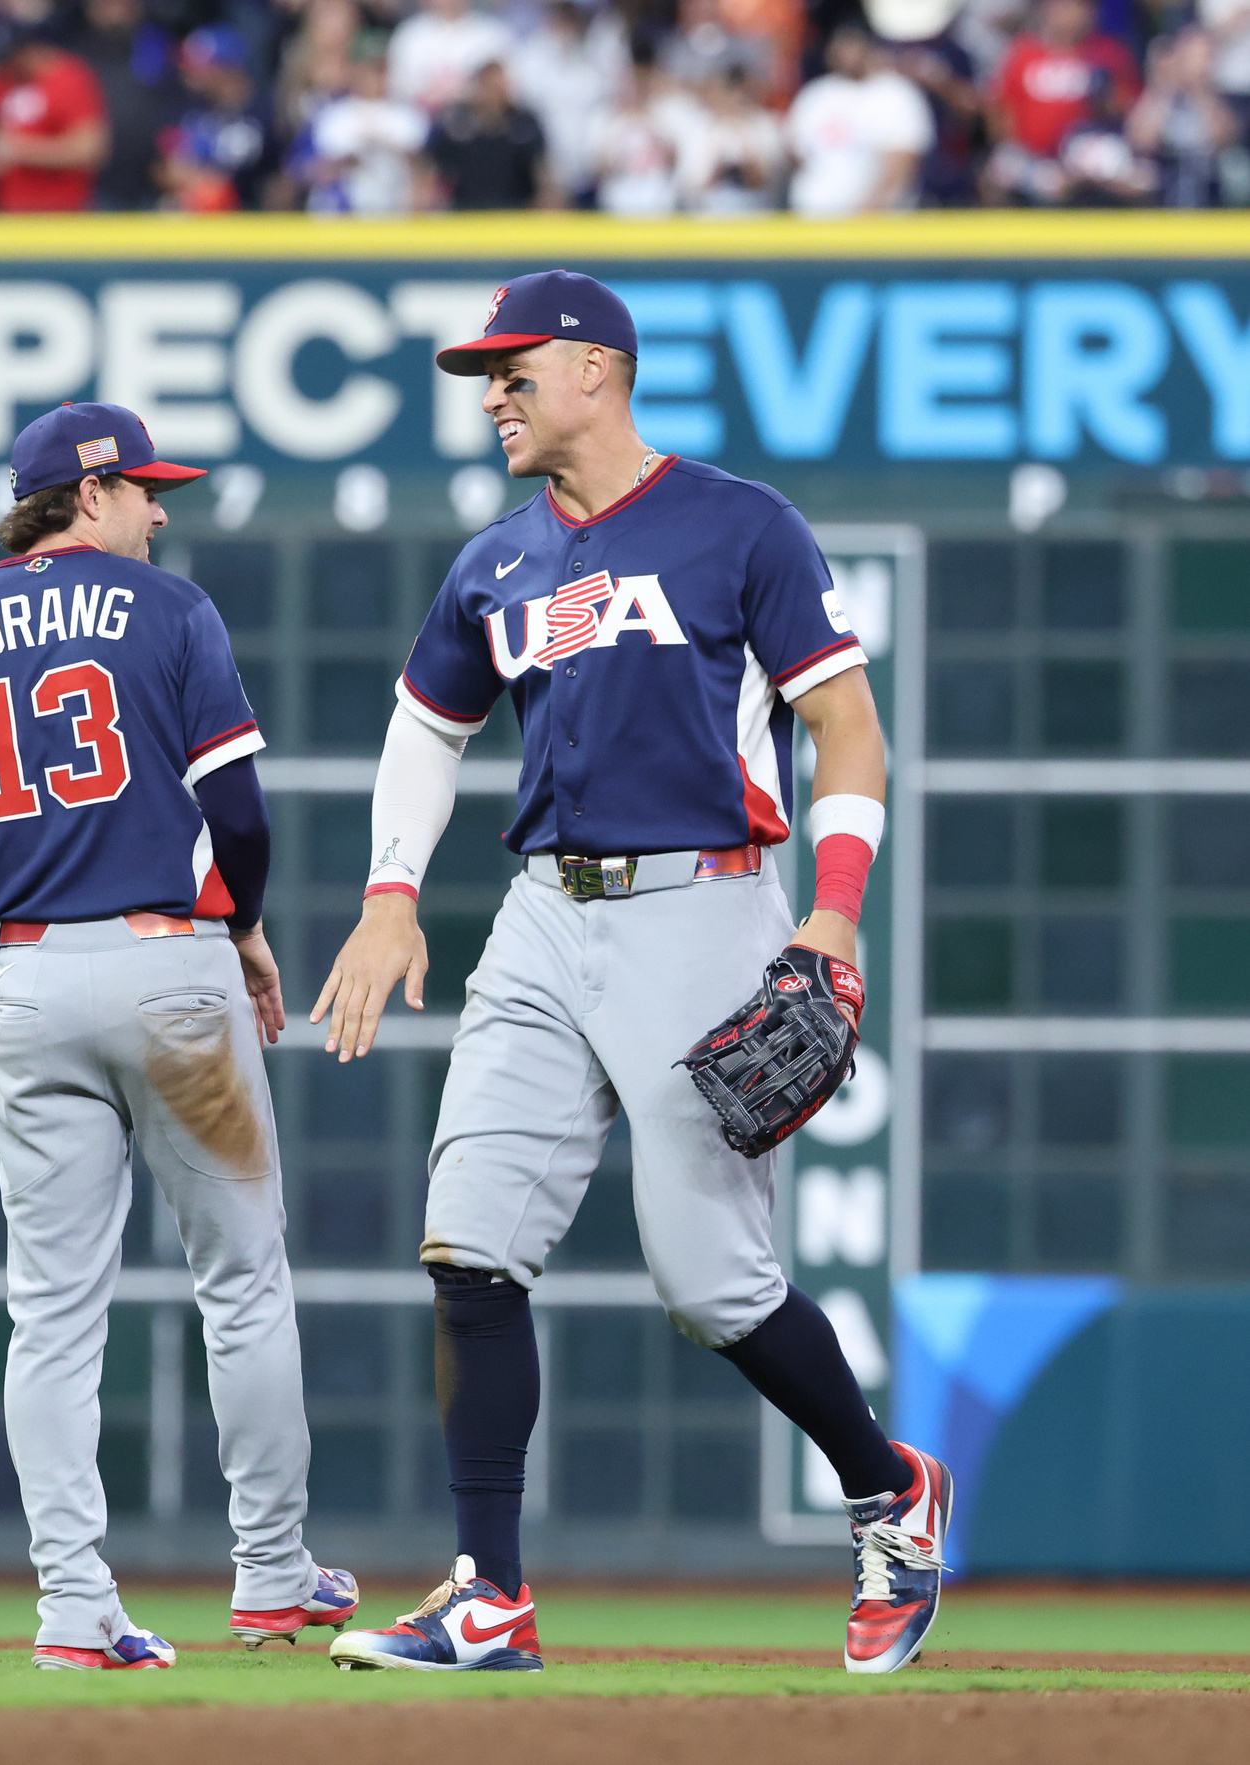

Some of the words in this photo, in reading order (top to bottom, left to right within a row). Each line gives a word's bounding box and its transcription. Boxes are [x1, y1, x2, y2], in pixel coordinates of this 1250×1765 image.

[484, 570, 688, 679] USA
[607, 869, 624, 888] 99
[743, 1005, 767, 1030] Aaron
[711, 1028, 739, 1049] Judge
